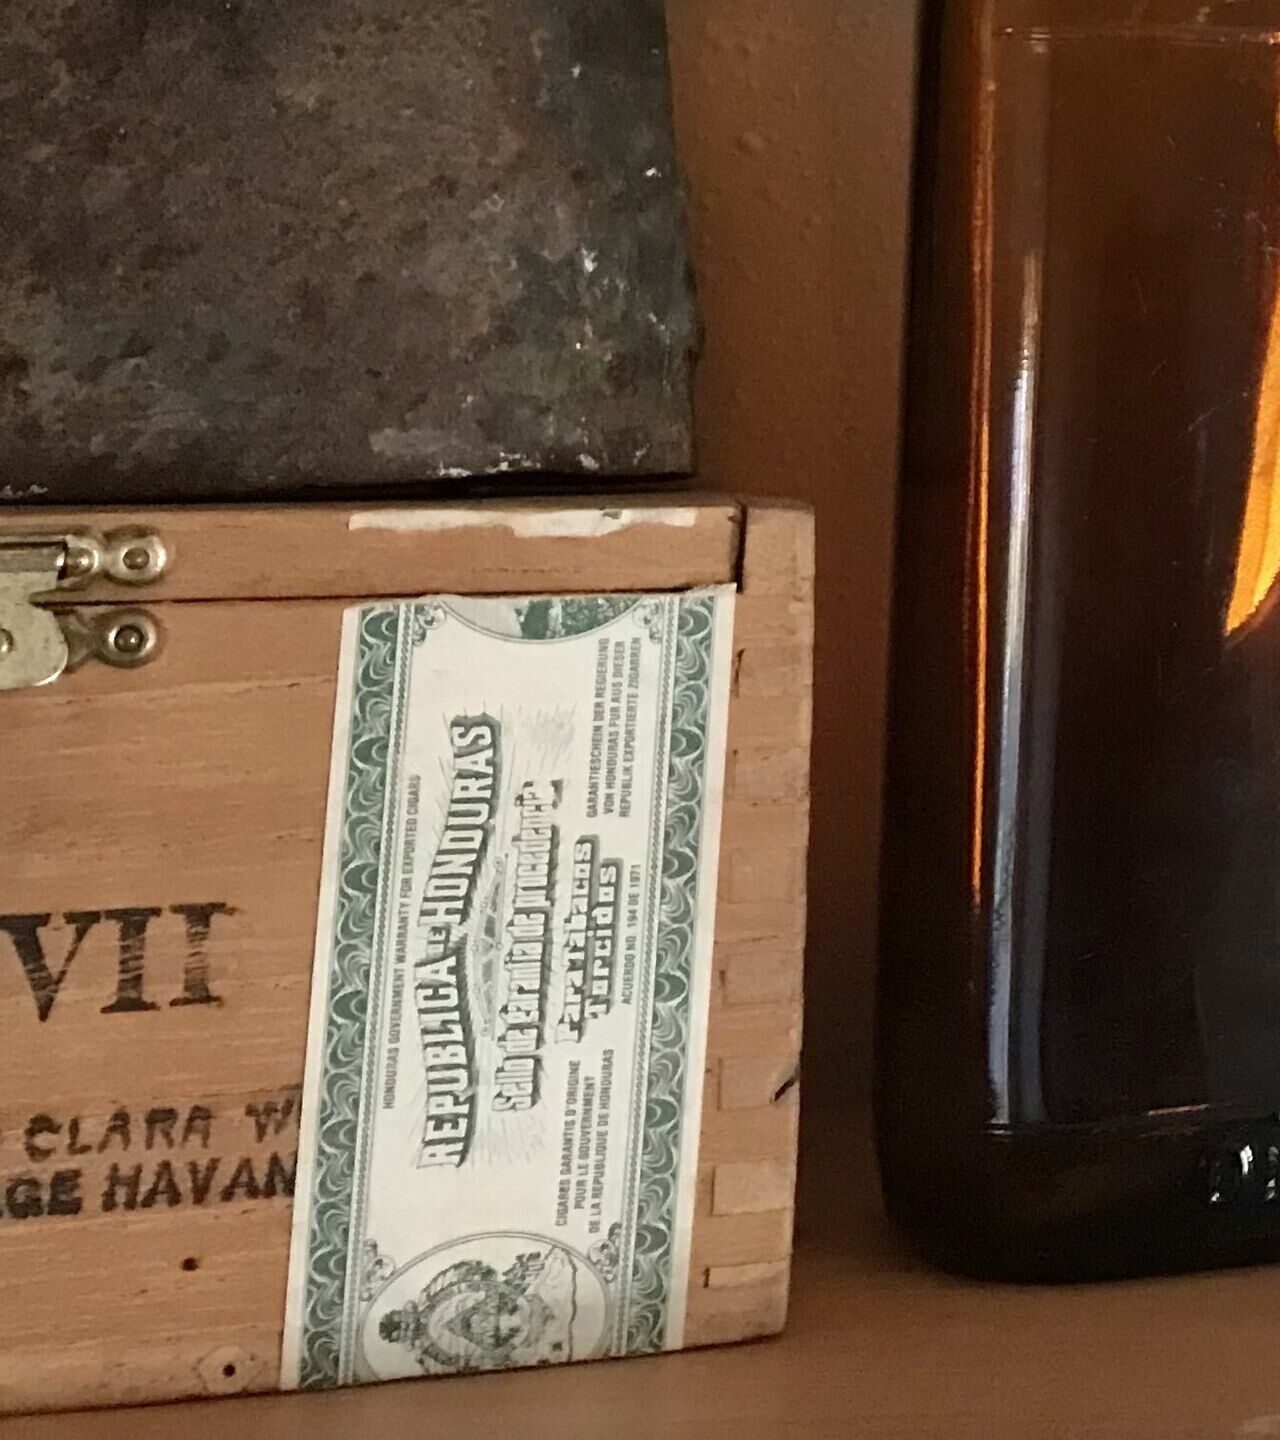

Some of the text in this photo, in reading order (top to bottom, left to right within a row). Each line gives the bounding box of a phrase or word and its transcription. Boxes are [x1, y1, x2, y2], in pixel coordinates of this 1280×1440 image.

[613, 641, 625, 678] DIESER
[611, 682, 623, 703] AUS
[586, 638, 610, 818] GARANTIESCHEIN DER REGIERUNG
[619, 637, 641, 817] REPUBLIK EXPORTIERTE ZIGARREN
[605, 731, 620, 789] HONDURAS
[418, 716, 500, 926] HONDURAS
[603, 793, 615, 814] VON
[628, 893, 639, 906] DE
[629, 864, 641, 888] 1971
[382, 775, 420, 1109] HONDURAS GOVERNMENT WARRANTY FOR EXPORTED CIGARS
[506, 912, 547, 937] de
[621, 954, 635, 1005] ACUERDO
[413, 955, 476, 1168] REPUBLICA
[497, 1026, 540, 1053] de
[491, 1057, 538, 1111] Sello
[24, 1106, 213, 1161] CLARA
[555, 1060, 580, 1226] CIGARES GARANTIS D'ORIGINE
[574, 1076, 595, 1210] POUR LE GOUVERNMENT
[588, 1048, 614, 1233] DE LA REPUBLIQUE DE HONDURAS
[0, 1169, 81, 1219] GE
